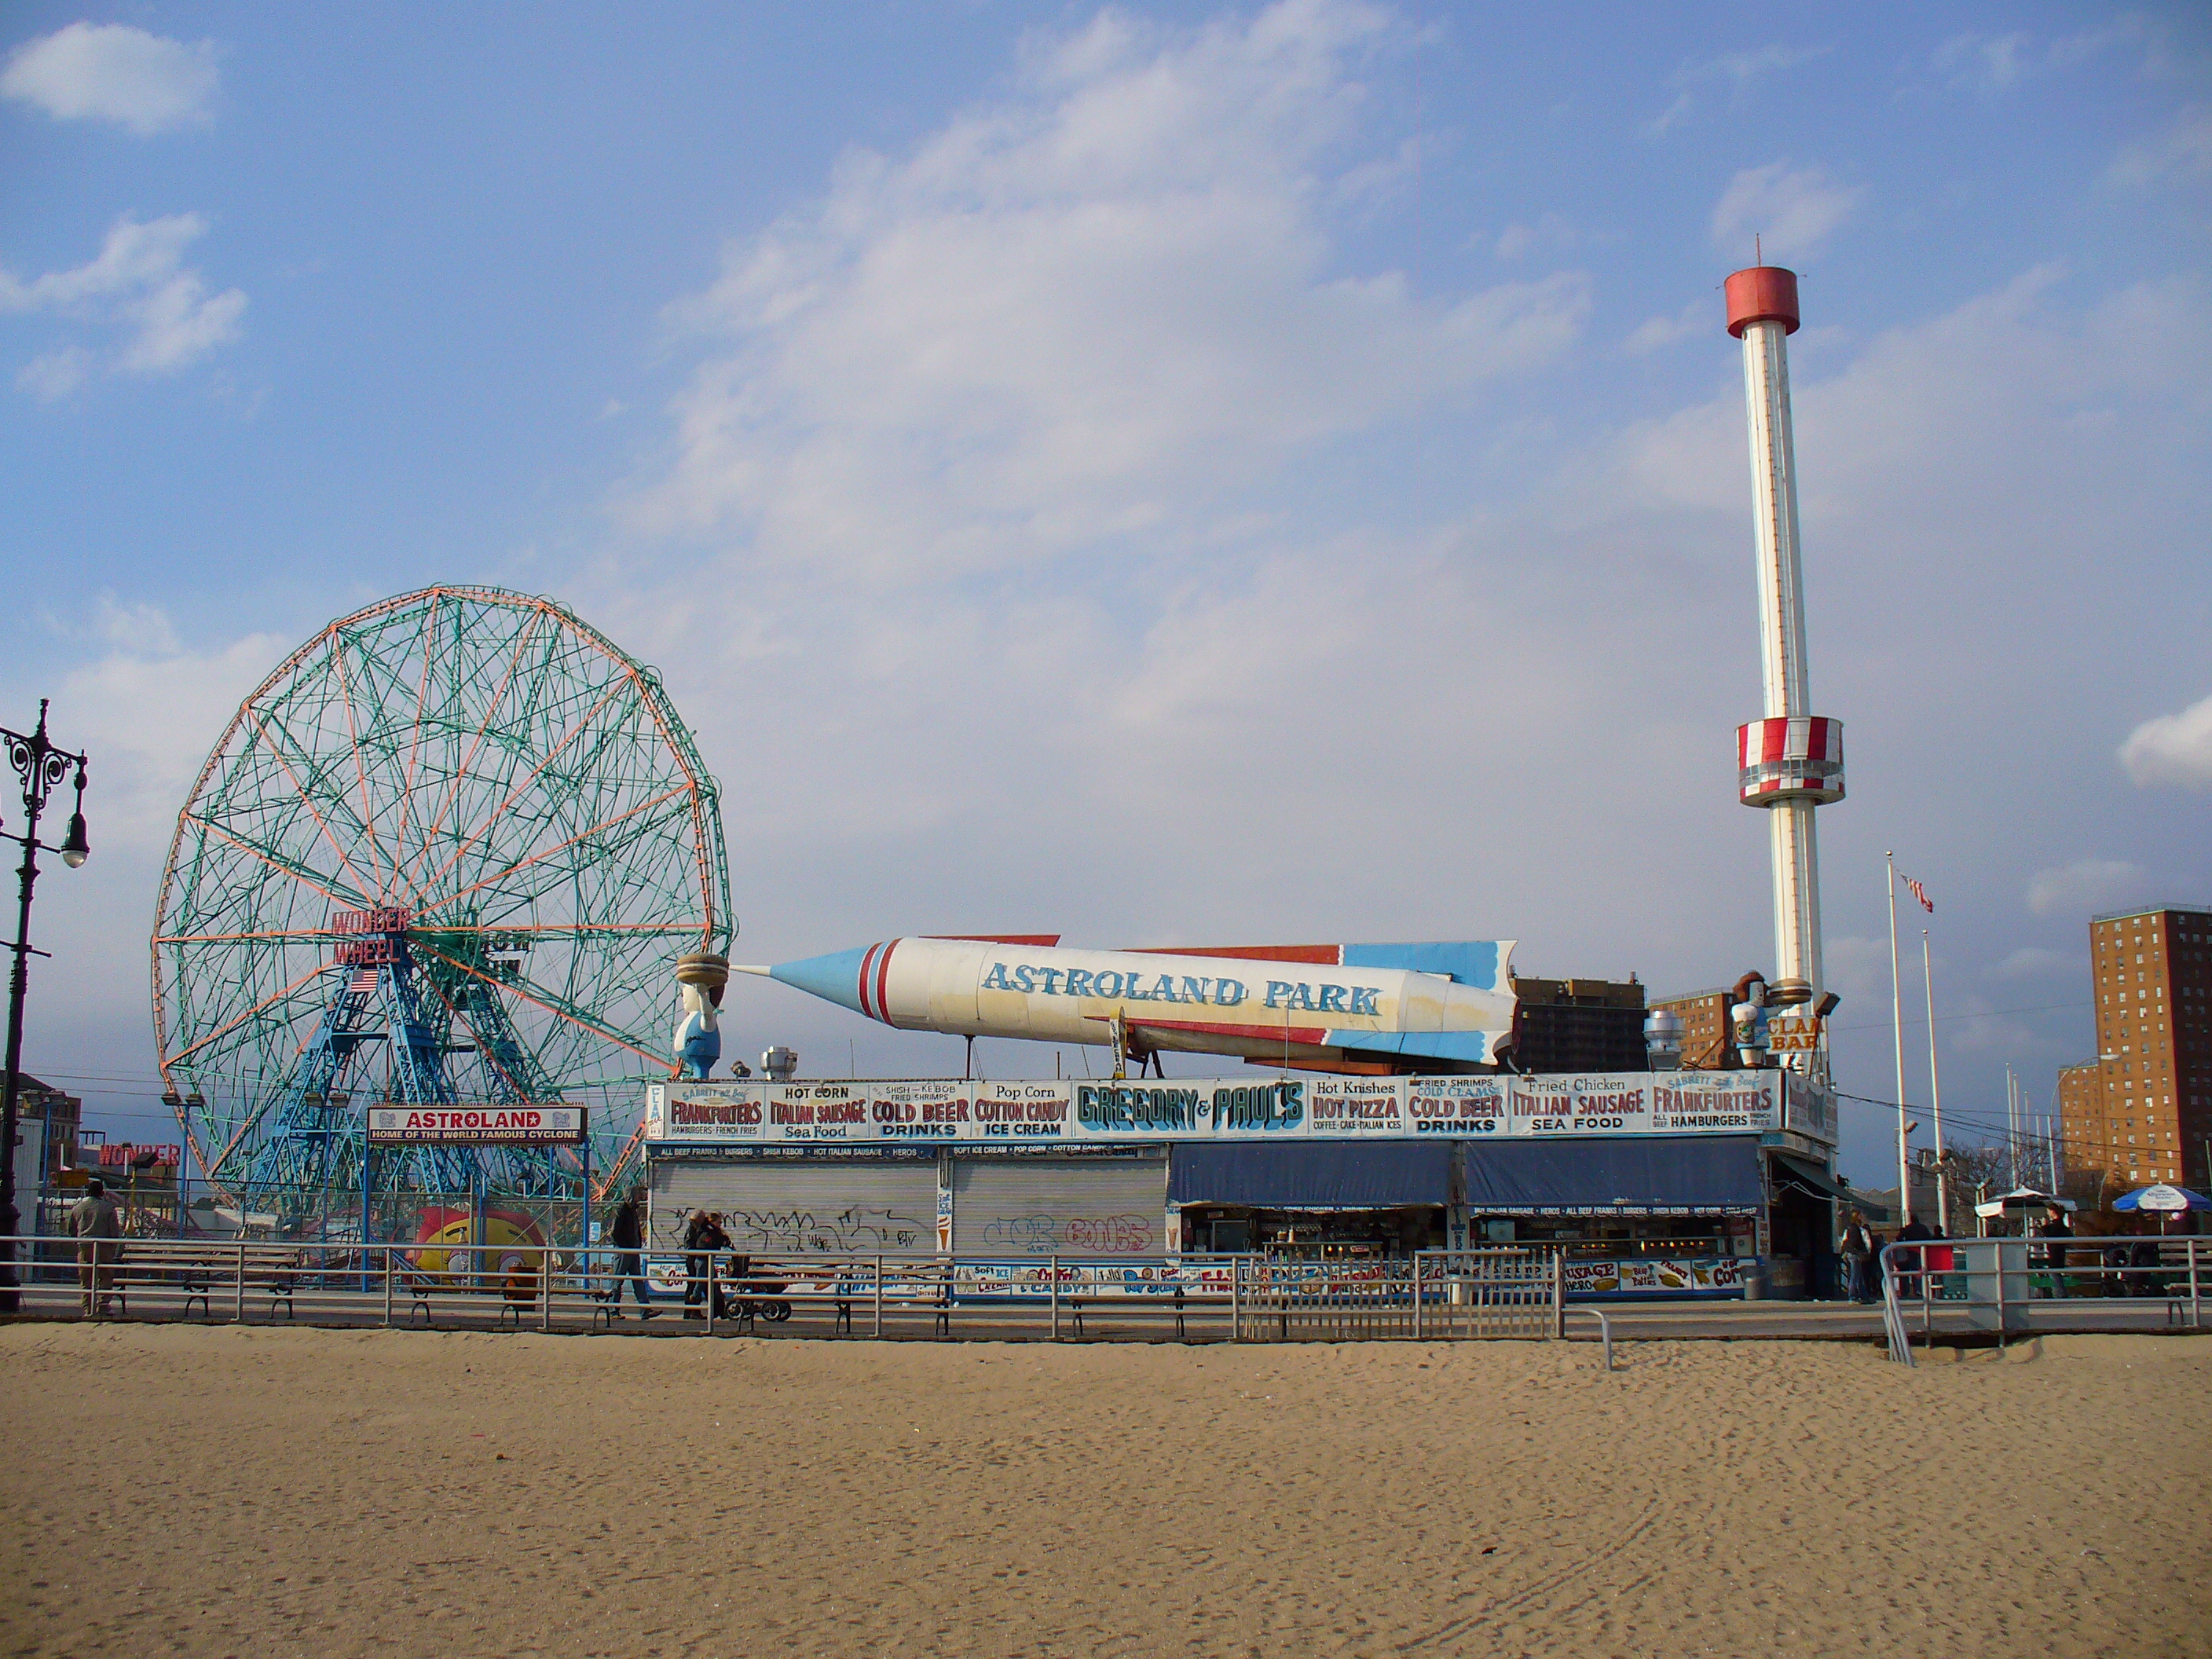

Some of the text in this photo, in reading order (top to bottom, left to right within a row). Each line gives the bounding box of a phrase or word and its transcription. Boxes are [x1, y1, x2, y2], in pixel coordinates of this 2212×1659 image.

[333, 907, 410, 935] WONDER
[335, 939, 401, 965] WHEEL
[982, 962, 1383, 1016] ASTROLAND PARK
[1771, 1035, 1817, 1050] BAR
[921, 1085, 956, 1093] KEBOB
[1317, 1082, 1395, 1094] Hot Knishes
[1528, 1079, 1625, 1092] Fried Chicken
[1668, 1077, 1710, 1089] SABRETT
[786, 1088, 848, 1099] HOT CORN
[996, 1085, 1055, 1100] Pop Corn
[1417, 1086, 1496, 1097] COLD CLAMS
[651, 1088, 660, 1119] CLAM
[1408, 1096, 1504, 1118] COLD BEER
[1513, 1089, 1645, 1116] ITALIAN SAUSAGE
[1654, 1086, 1772, 1113] FRANKFURTERS
[671, 1100, 763, 1125] FRANKFURTERS
[770, 1099, 866, 1124] ITALIAN SAUSAGE
[872, 1099, 970, 1123] COLD BEER
[975, 1099, 1070, 1122] COTTON CANDY
[1078, 1086, 1198, 1131] GREGORY
[1197, 1099, 1210, 1118] &
[1313, 1097, 1400, 1119] HOT PIZZA
[406, 1111, 541, 1128] ASTROLAND
[1313, 1121, 1401, 1130] COFFEE CAKE ITALIAN ICES
[1417, 1120, 1496, 1132] DRINKS
[1533, 1118, 1623, 1130] SEA FOOD
[1671, 1115, 1747, 1127] HAMBURGERS
[529, 1130, 578, 1139] CYCLONE
[672, 1126, 758, 1135] HAMBURGERS FRENCH FRIES
[786, 1126, 847, 1137] Sea Food
[882, 1124, 957, 1137] DRINKS
[985, 1123, 1060, 1136] ICE CREAM
